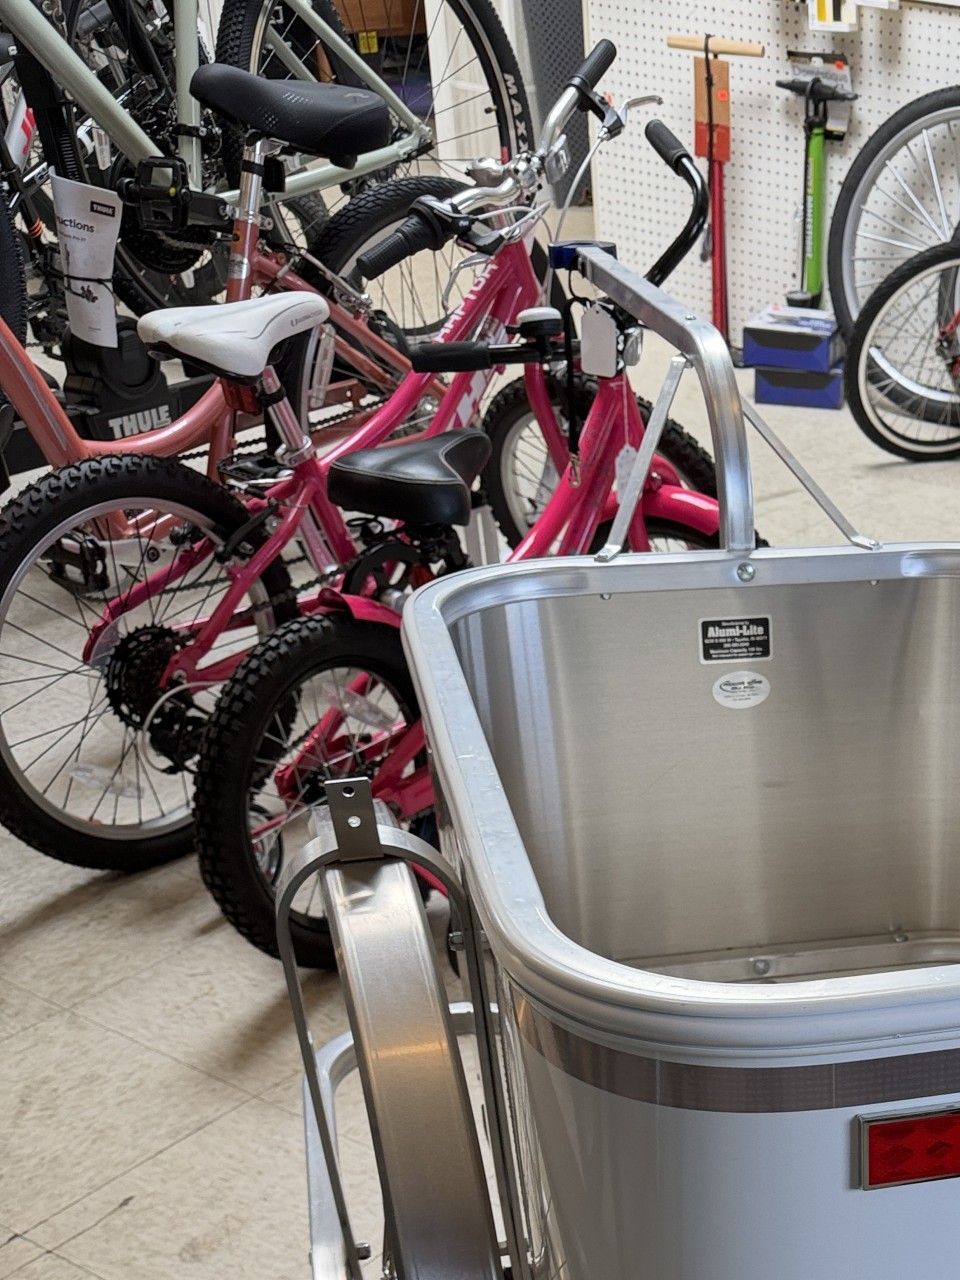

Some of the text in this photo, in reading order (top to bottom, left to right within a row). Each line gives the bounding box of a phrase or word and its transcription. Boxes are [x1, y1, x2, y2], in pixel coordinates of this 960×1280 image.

[503, 73, 529, 153] MAXX
[59, 218, 95, 233] uctions
[108, 404, 172, 439] THULE
